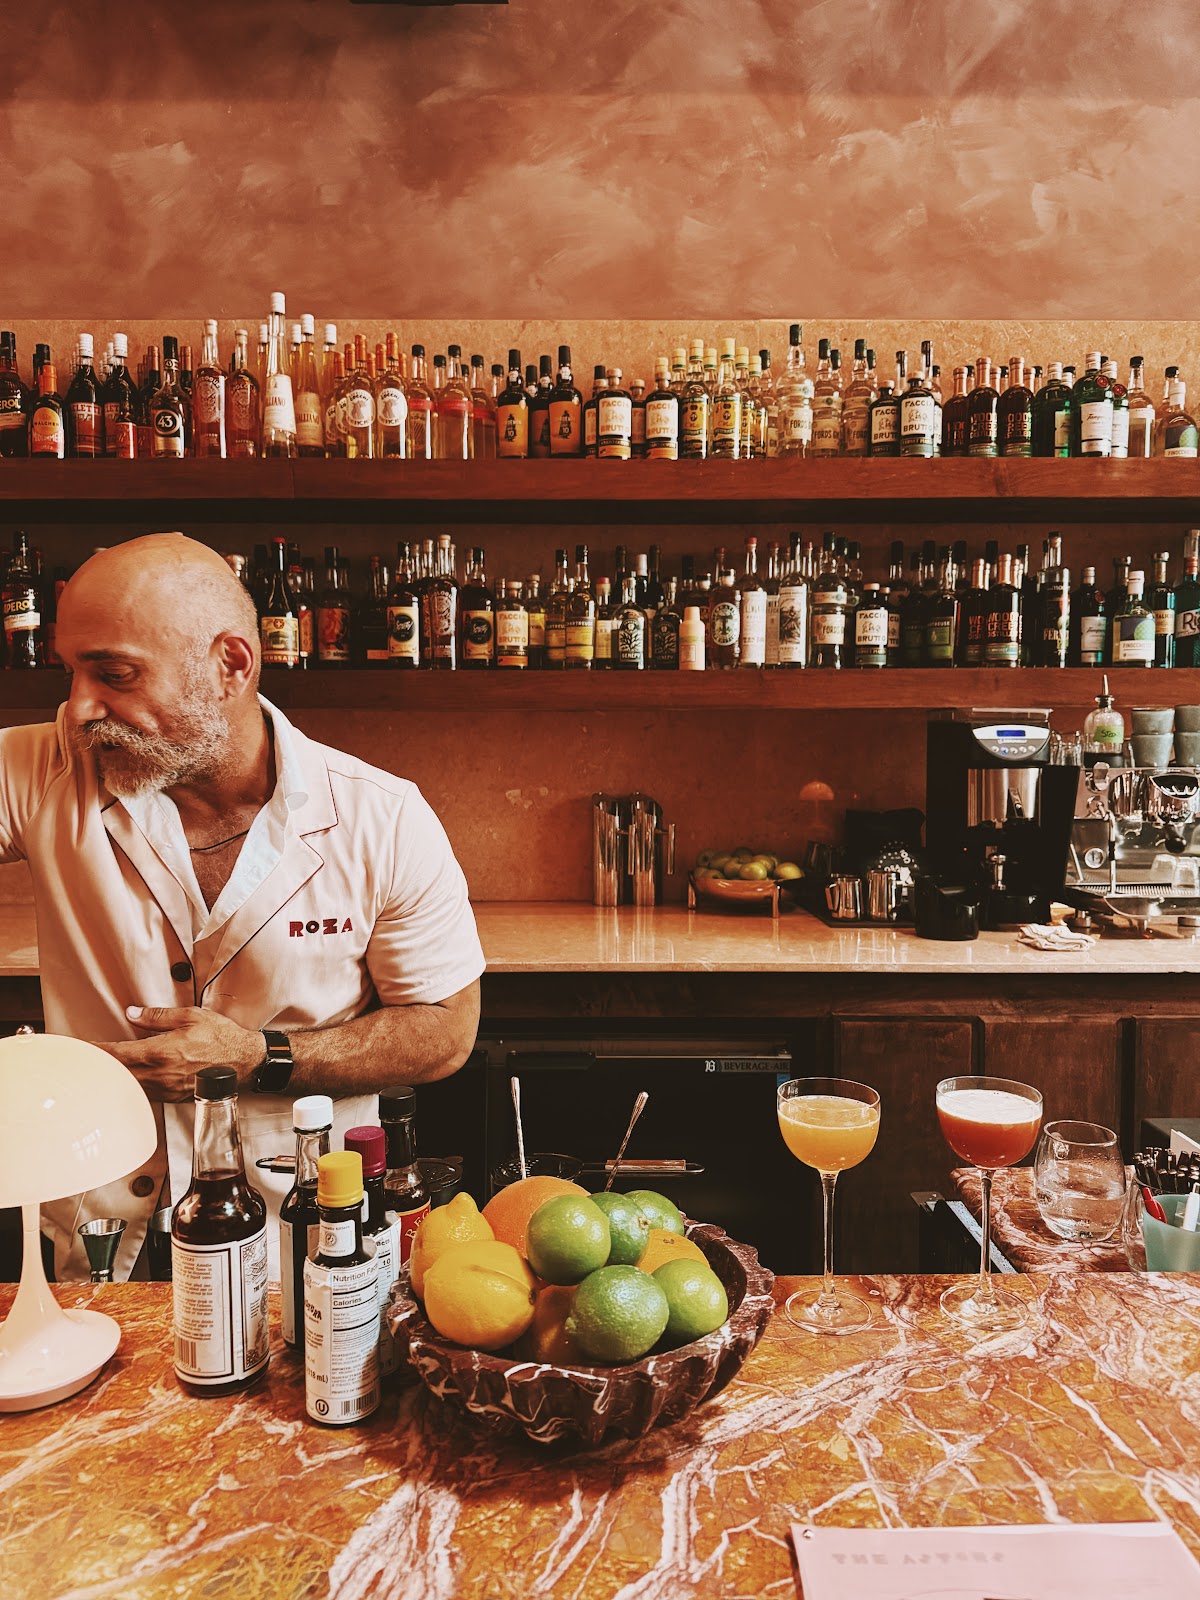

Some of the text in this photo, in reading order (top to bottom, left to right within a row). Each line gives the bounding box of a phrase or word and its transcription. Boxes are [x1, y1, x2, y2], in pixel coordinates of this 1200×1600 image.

[0, 399, 21, 410] EROL
[601, 400, 630, 408] FACCIA
[904, 400, 932, 408] FACCIA
[157, 415, 174, 429] 43
[601, 424, 630, 433] BRUTTO
[647, 427, 675, 435] BRUTTO
[903, 423, 933, 432] BRUTTO
[814, 429, 832, 439] FORDS
[853, 430, 868, 439] FORD
[873, 431, 897, 440] BRUT
[4, 600, 34, 614] APERO
[499, 636, 526, 644] BRUTTO
[857, 635, 886, 643] BRUTTO
[289, 917, 353, 937] ROZA
[724, 1061, 789, 1071] BEVERAGE-AIR
[333, 1270, 366, 1282] Nutrition
[333, 1297, 361, 1307] Calories
